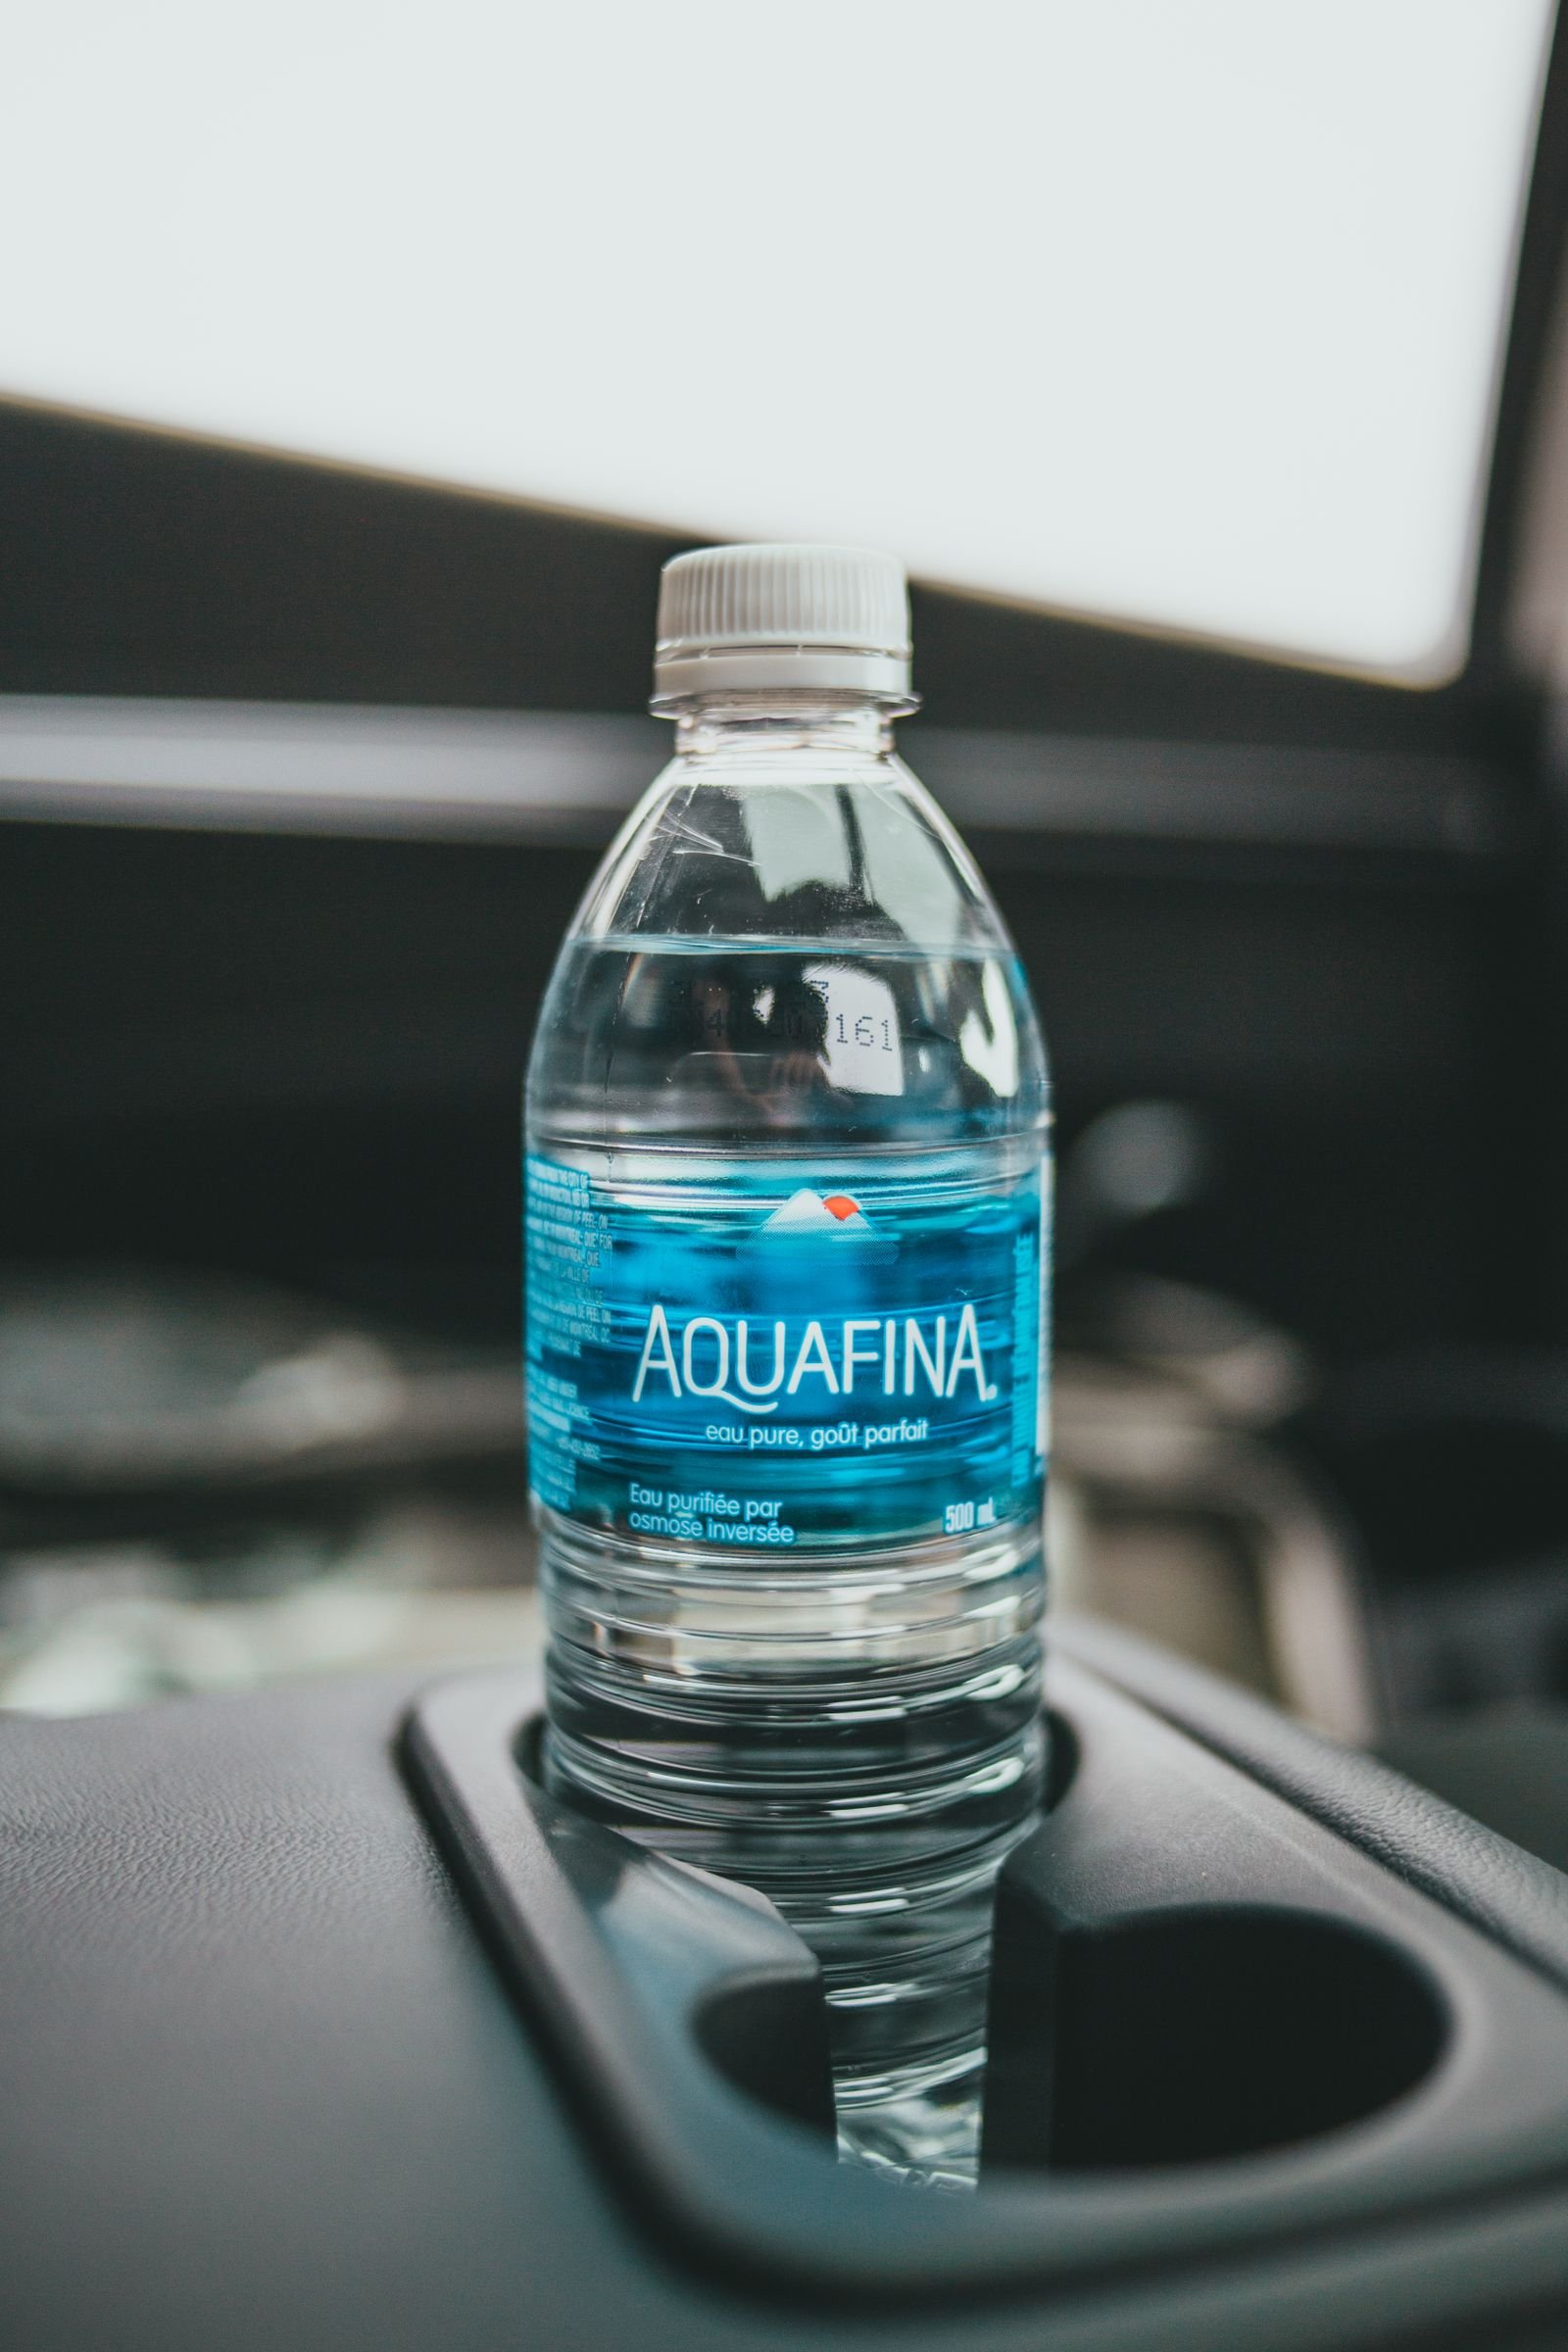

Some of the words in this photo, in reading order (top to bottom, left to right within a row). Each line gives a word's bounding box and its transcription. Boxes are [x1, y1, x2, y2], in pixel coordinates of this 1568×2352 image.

[835, 1012, 893, 1053] 161
[632, 1303, 988, 1414] AQUAFINA
[706, 1425, 745, 1445] eau
[748, 1425, 805, 1450] pure,
[810, 1421, 858, 1450] goût
[862, 1417, 929, 1449] parfait
[629, 1483, 662, 1507] Eau
[667, 1490, 741, 1516] purifiée
[744, 1500, 782, 1522] par
[945, 1501, 974, 1534] 500
[629, 1512, 704, 1537] osmose
[707, 1516, 795, 1543] inversée
